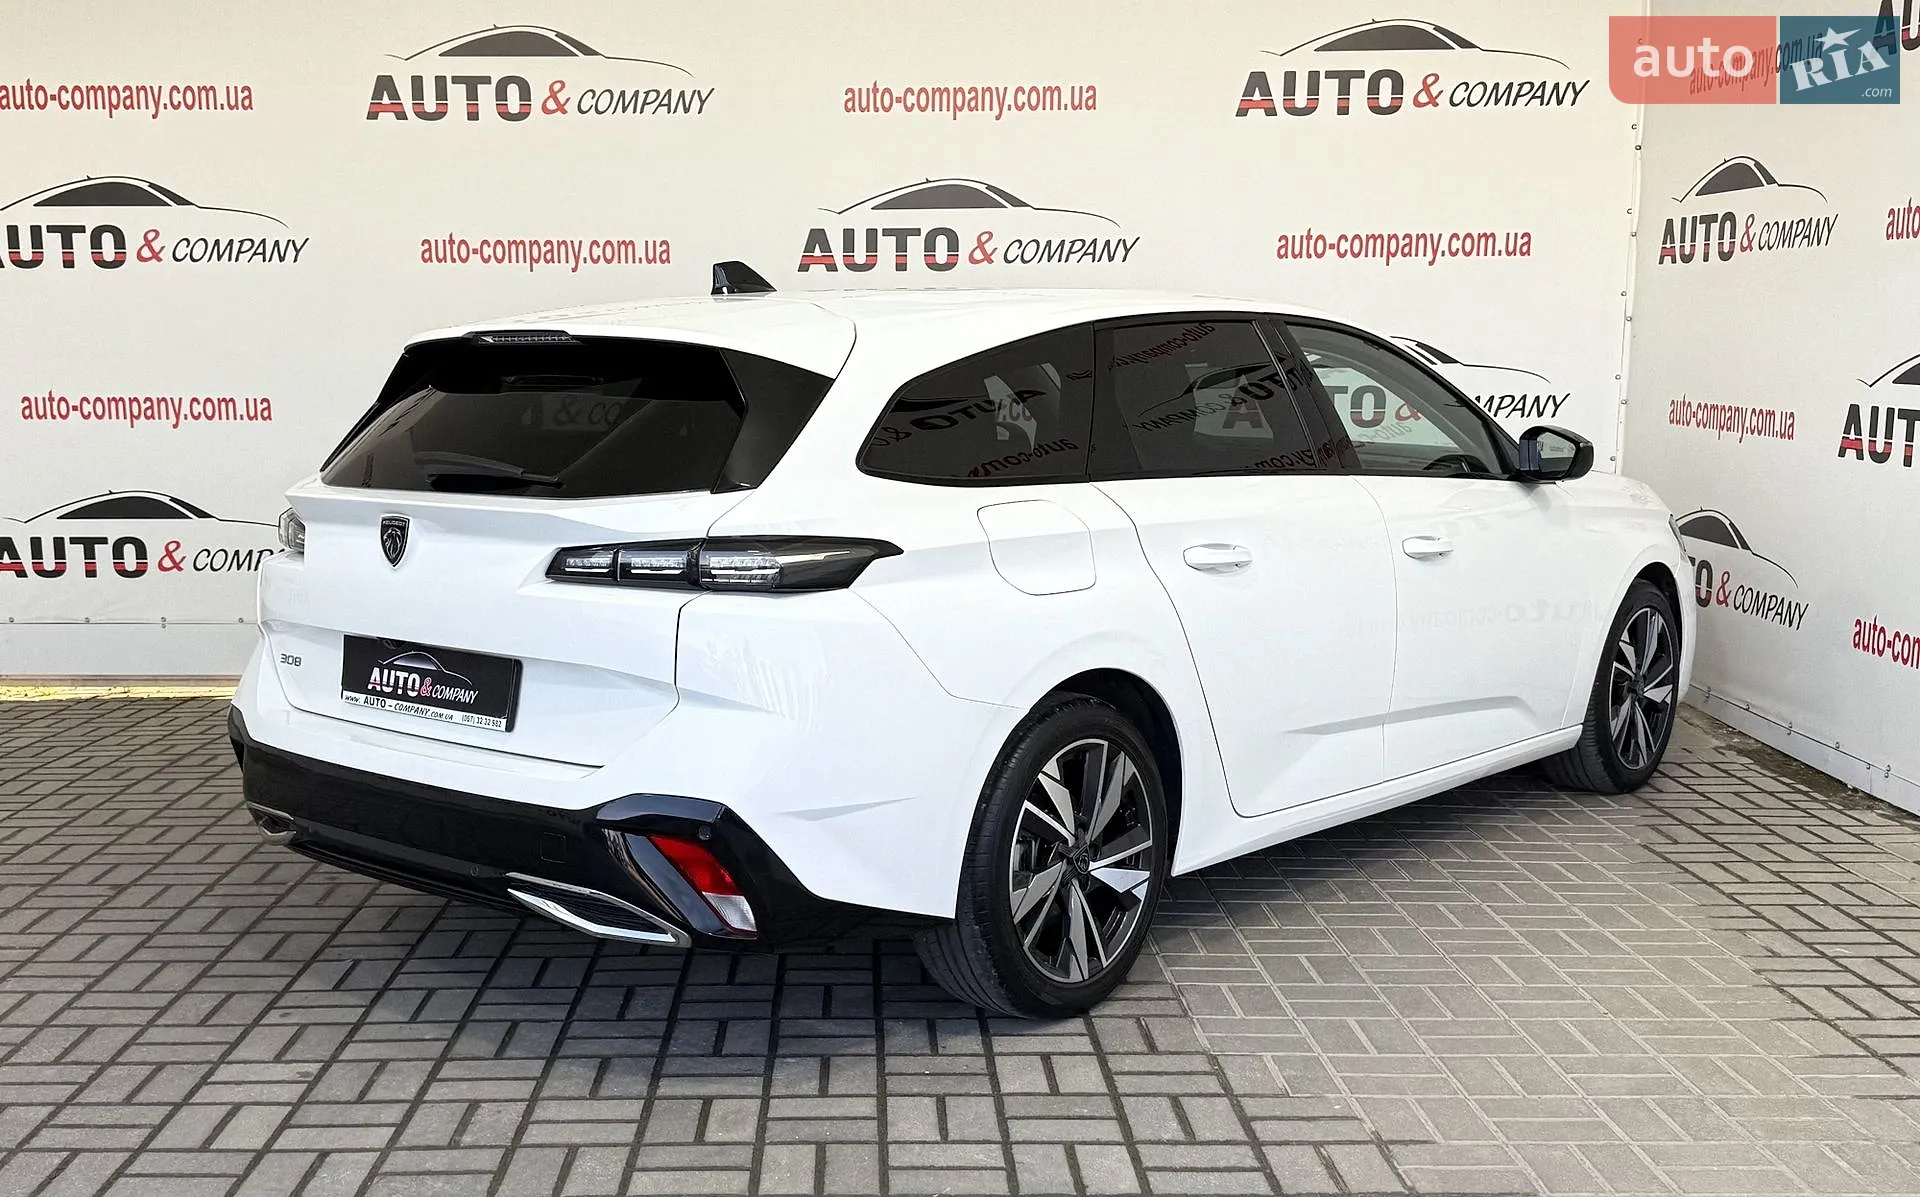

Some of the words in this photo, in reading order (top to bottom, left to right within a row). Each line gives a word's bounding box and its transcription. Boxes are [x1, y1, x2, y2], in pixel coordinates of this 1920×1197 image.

[0, 78, 253, 119] auto-company.com.ua
[366, 75, 531, 121] AUTO
[541, 80, 571, 115] &
[577, 87, 714, 115] COMPANY
[844, 81, 1097, 120] auto-company.com.ua
[1235, 69, 1404, 117] AUTO
[1412, 72, 1443, 108] &
[1449, 79, 1590, 108] COMPANY
[0, 225, 126, 269] UTO
[137, 229, 165, 262] &
[172, 237, 309, 264] COMPANY
[421, 232, 670, 272] auto-company.com.ua
[798, 227, 960, 272] AUTO
[969, 231, 998, 265] &
[1004, 236, 1140, 265] COMPANY
[1277, 228, 1532, 266] auto-company.com.ua
[1659, 212, 1736, 264] AUTO
[1740, 213, 1756, 253] &
[1758, 213, 1838, 251] COMPANY
[21, 389, 272, 429] auto-company.com.ua
[1669, 394, 1795, 443] auto-company.com.ua
[1838, 404, 1920, 467] AUT
[0, 536, 148, 578] AUTO
[157, 540, 187, 572] &
[193, 548, 284, 572] COMP
[1716, 571, 1731, 607] &
[1734, 584, 1809, 631] COMPANY
[280, 653, 302, 667] 308
[363, 696, 387, 708] AUTO
[368, 667, 421, 697] AUTO
[420, 677, 433, 697] &
[432, 685, 479, 704] COMPANY
